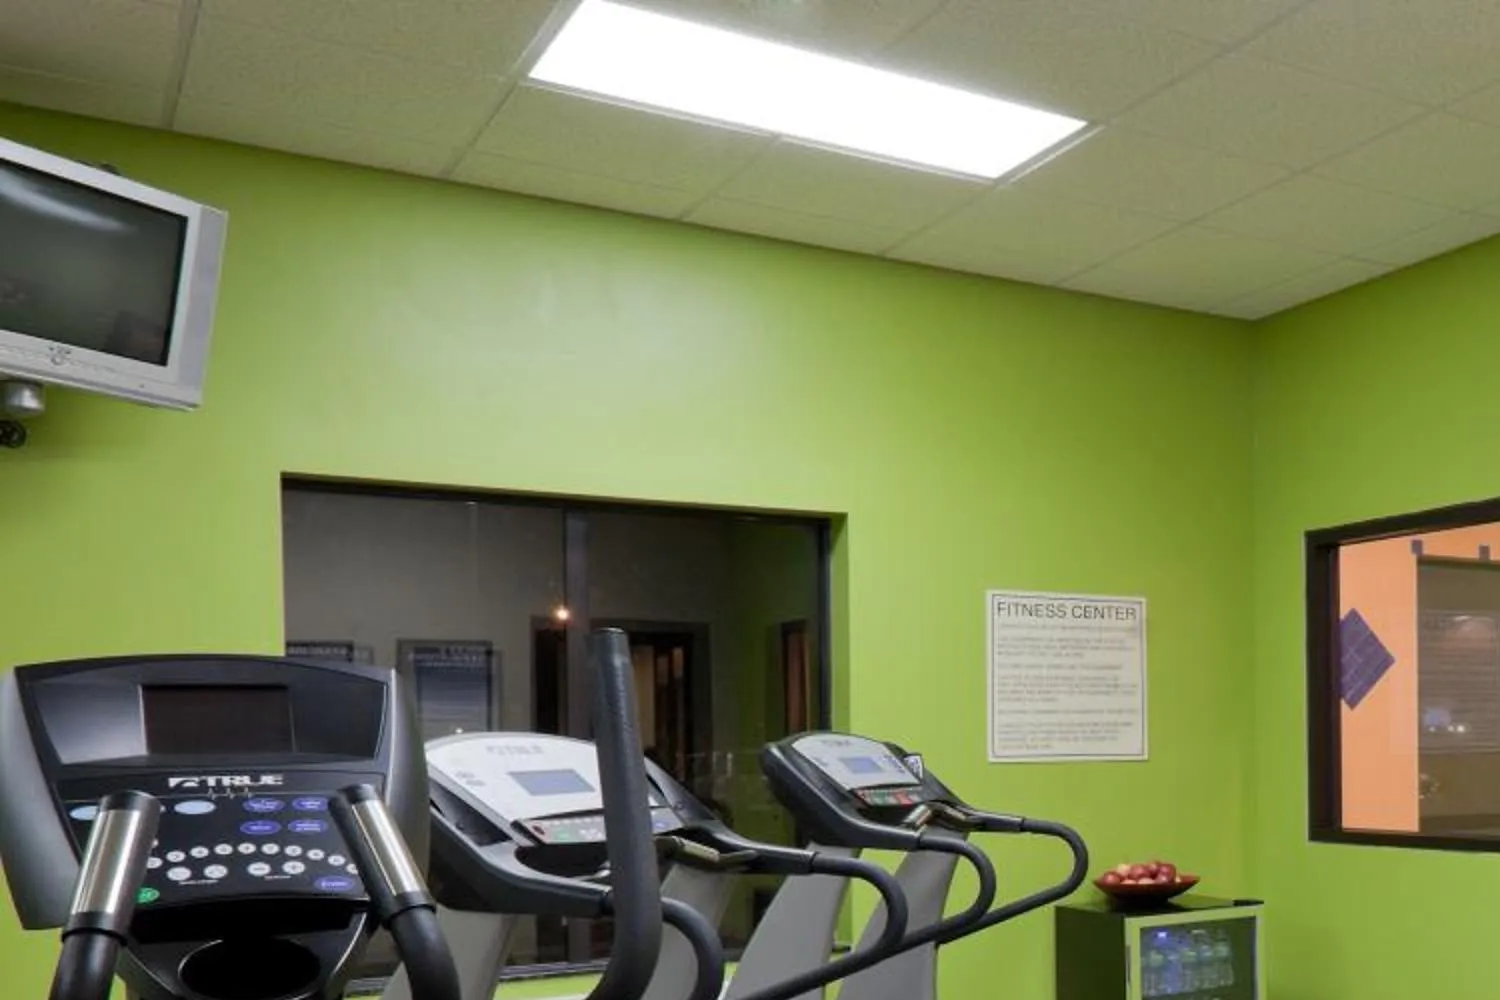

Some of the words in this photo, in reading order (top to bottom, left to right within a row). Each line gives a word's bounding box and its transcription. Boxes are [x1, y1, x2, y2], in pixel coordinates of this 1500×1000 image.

[997, 601, 1067, 619] FITNESS
[1071, 605, 1137, 621] CENTER
[201, 774, 284, 787] TRUE
